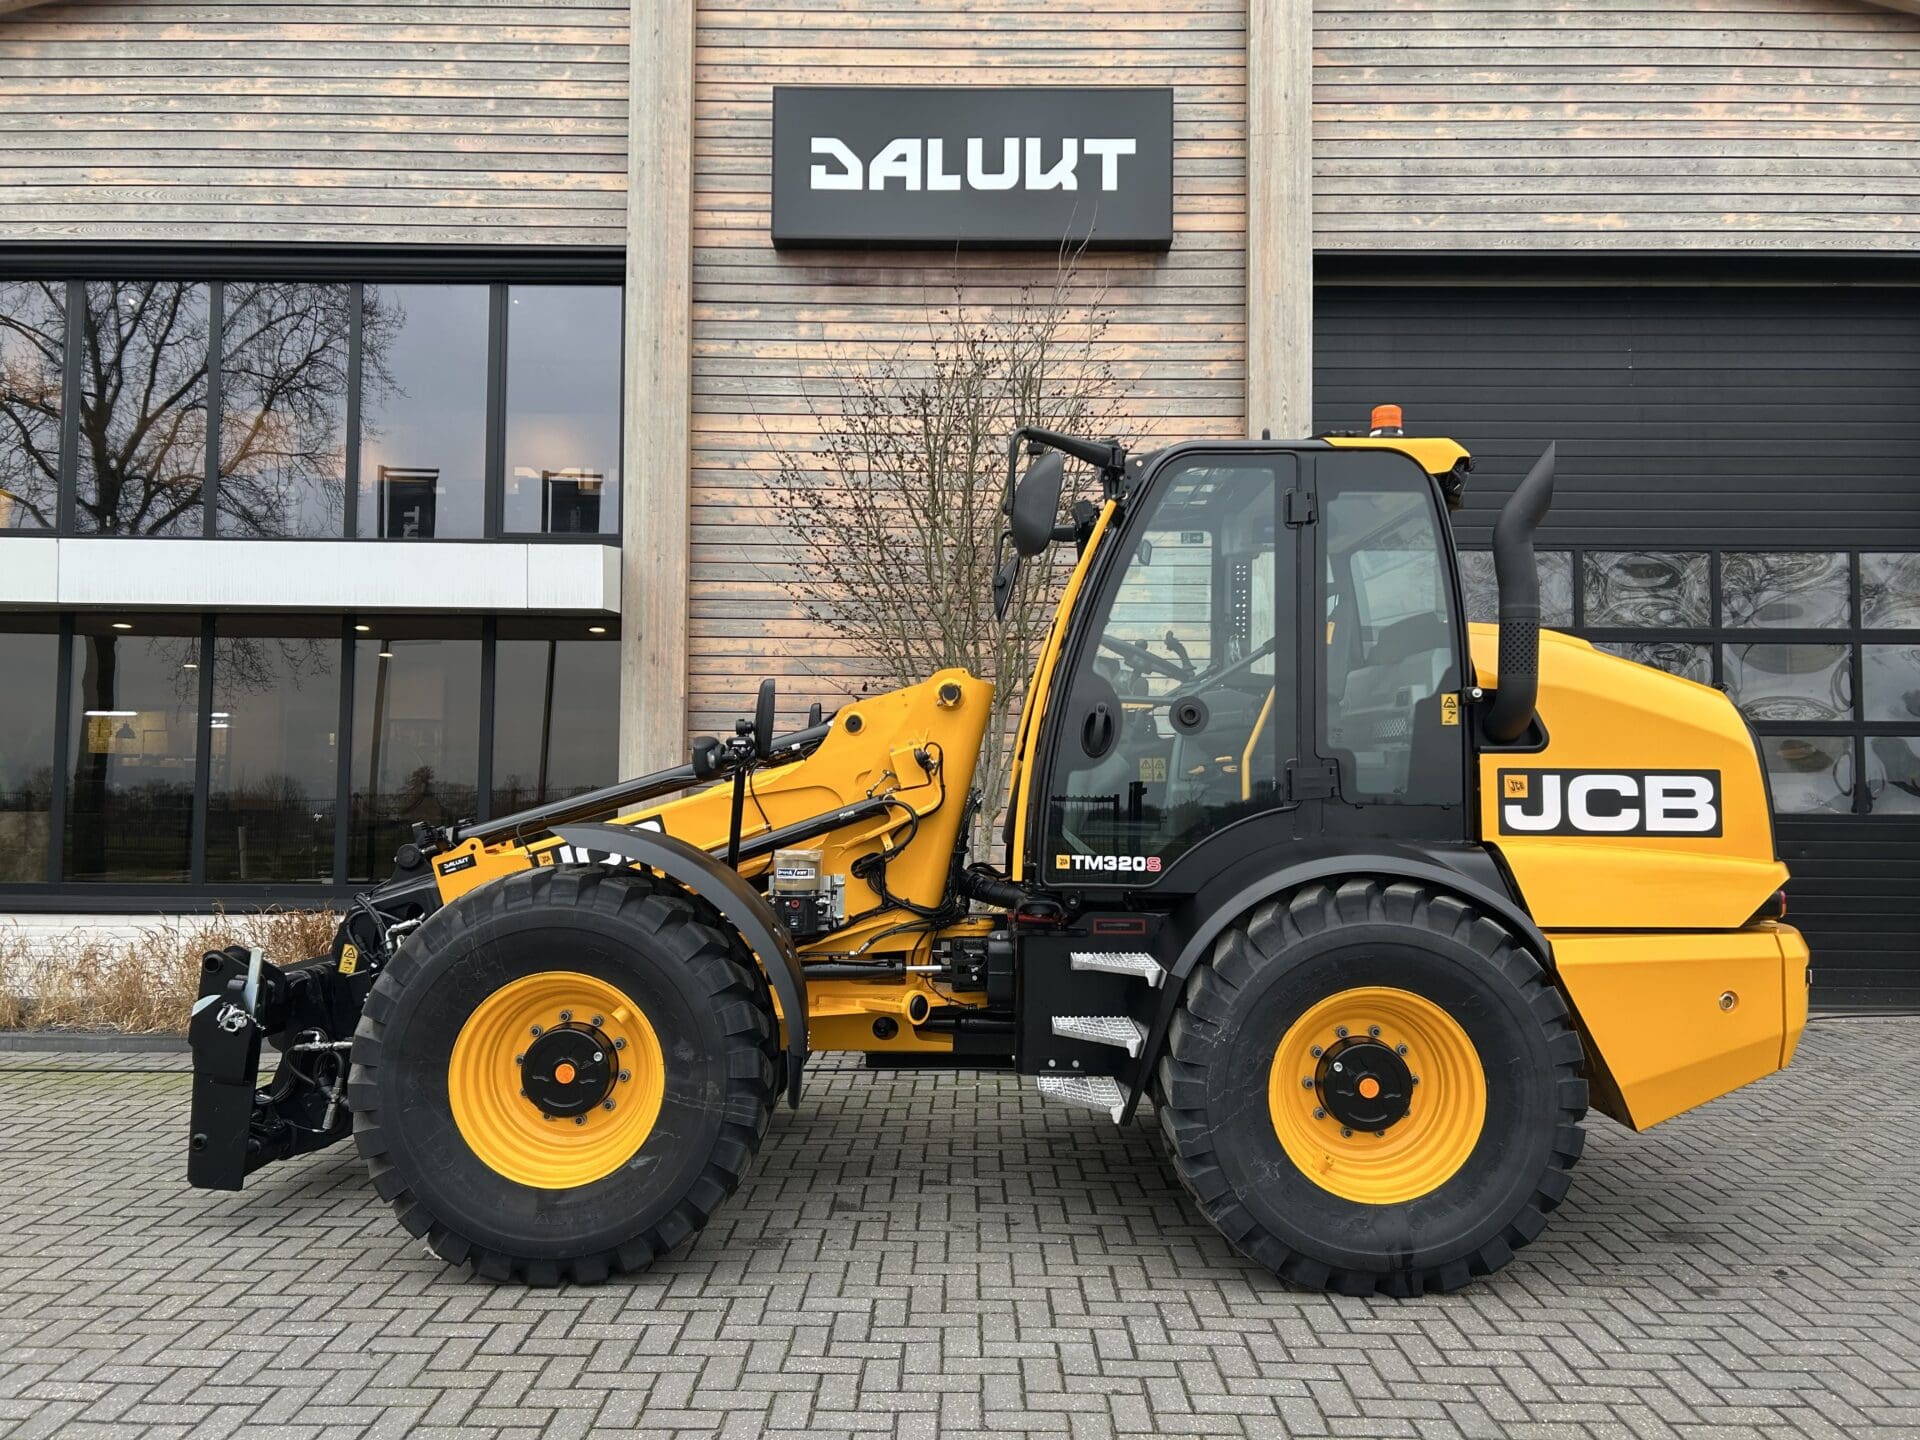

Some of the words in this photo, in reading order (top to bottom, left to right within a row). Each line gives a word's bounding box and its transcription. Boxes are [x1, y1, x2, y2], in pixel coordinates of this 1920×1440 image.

[810, 137, 1136, 191] DALUKT
[1504, 775, 1717, 831] JCB
[1071, 854, 1161, 872] TM320S
